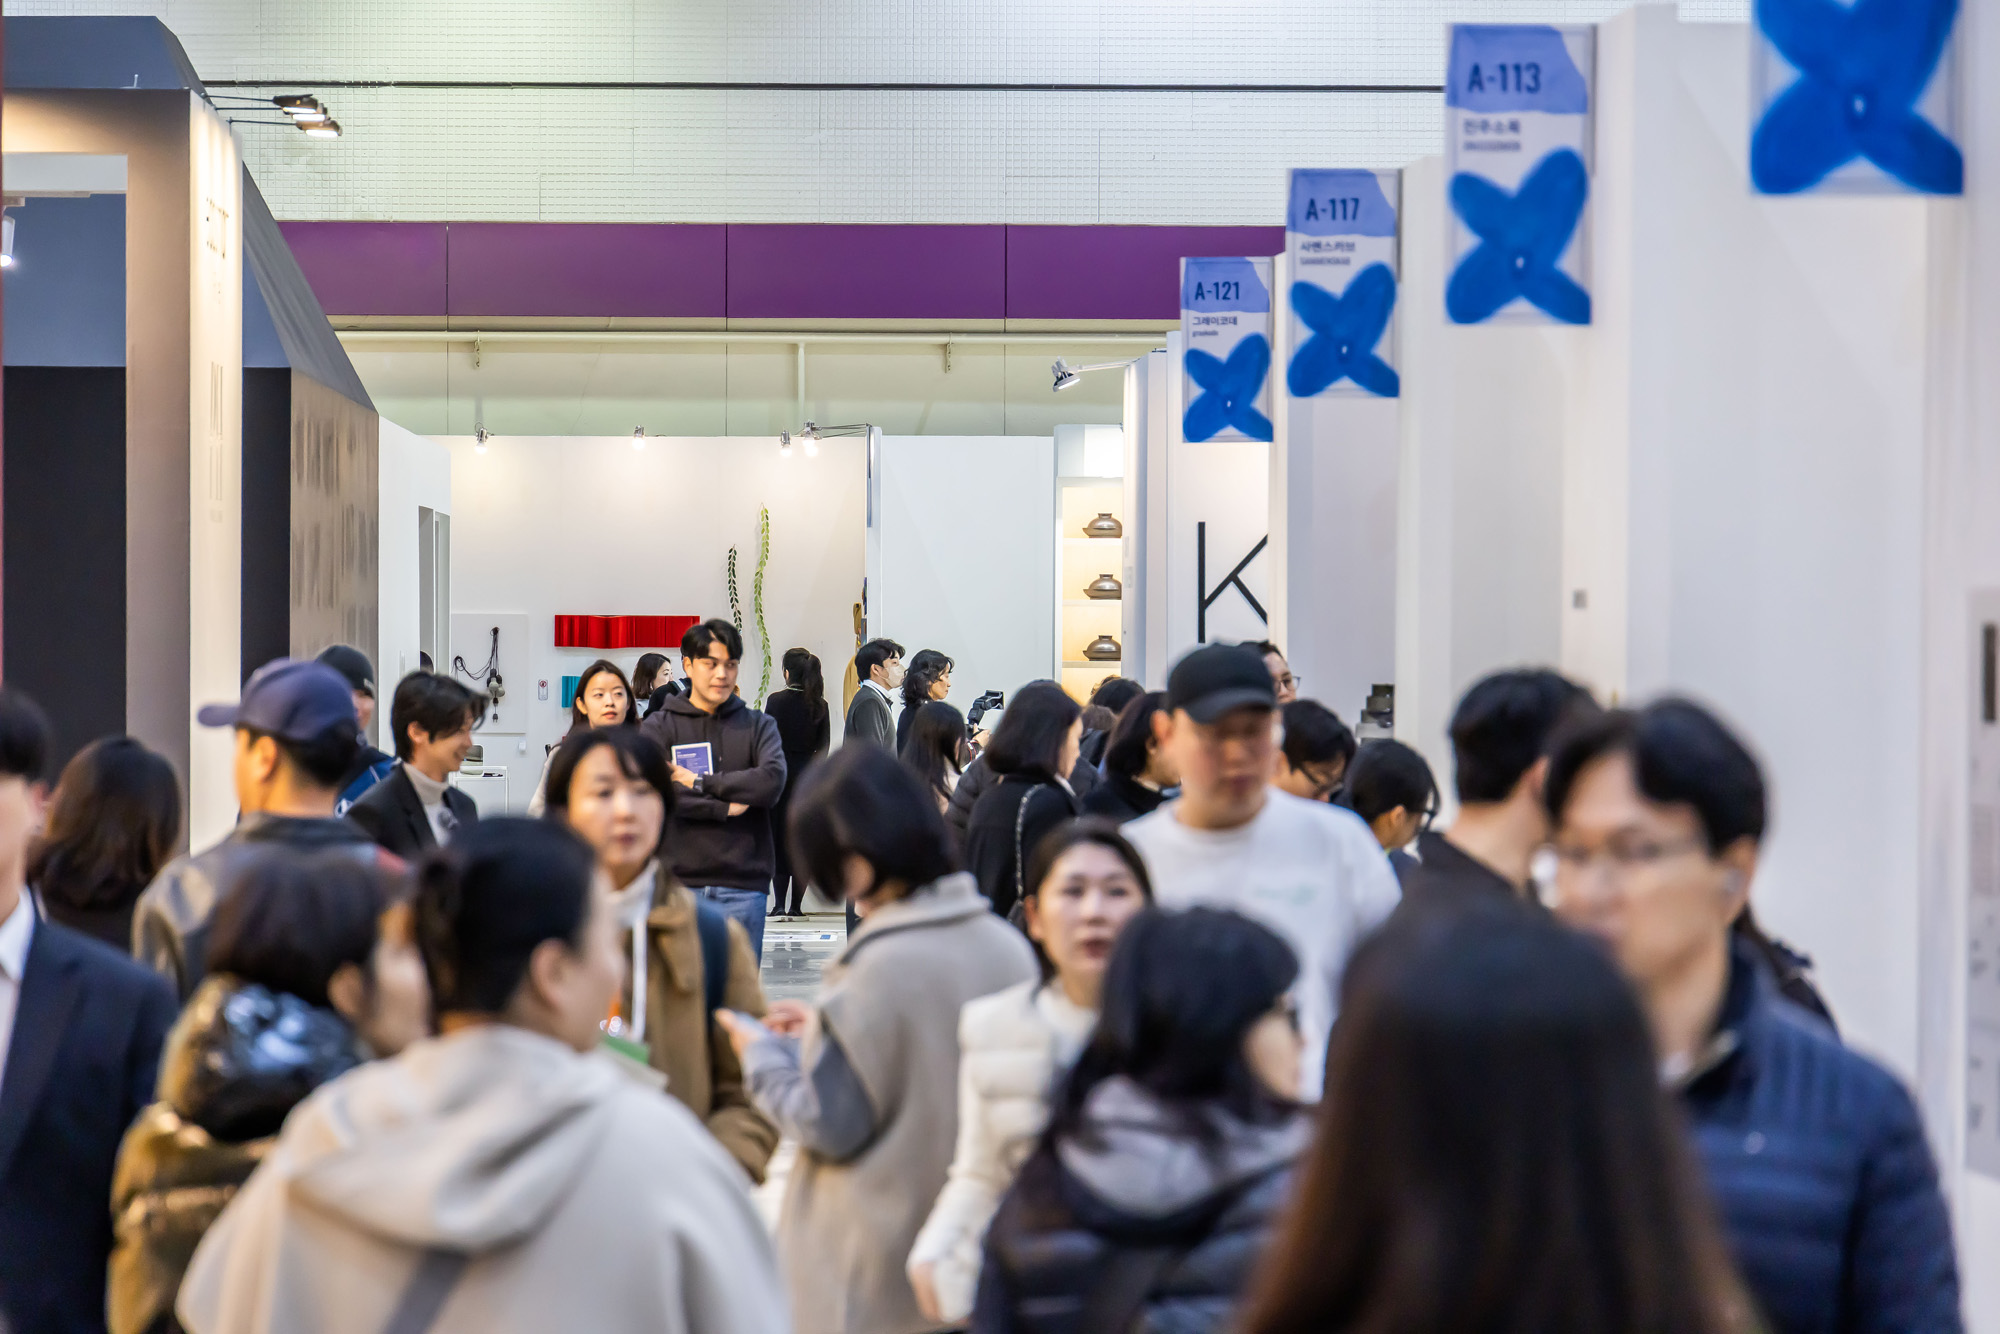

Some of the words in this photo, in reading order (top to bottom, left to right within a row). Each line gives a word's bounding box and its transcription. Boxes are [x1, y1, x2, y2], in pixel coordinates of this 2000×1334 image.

[1468, 62, 1541, 94] A-113
[1305, 198, 1360, 221] A-117
[1195, 281, 1240, 301] A-121
